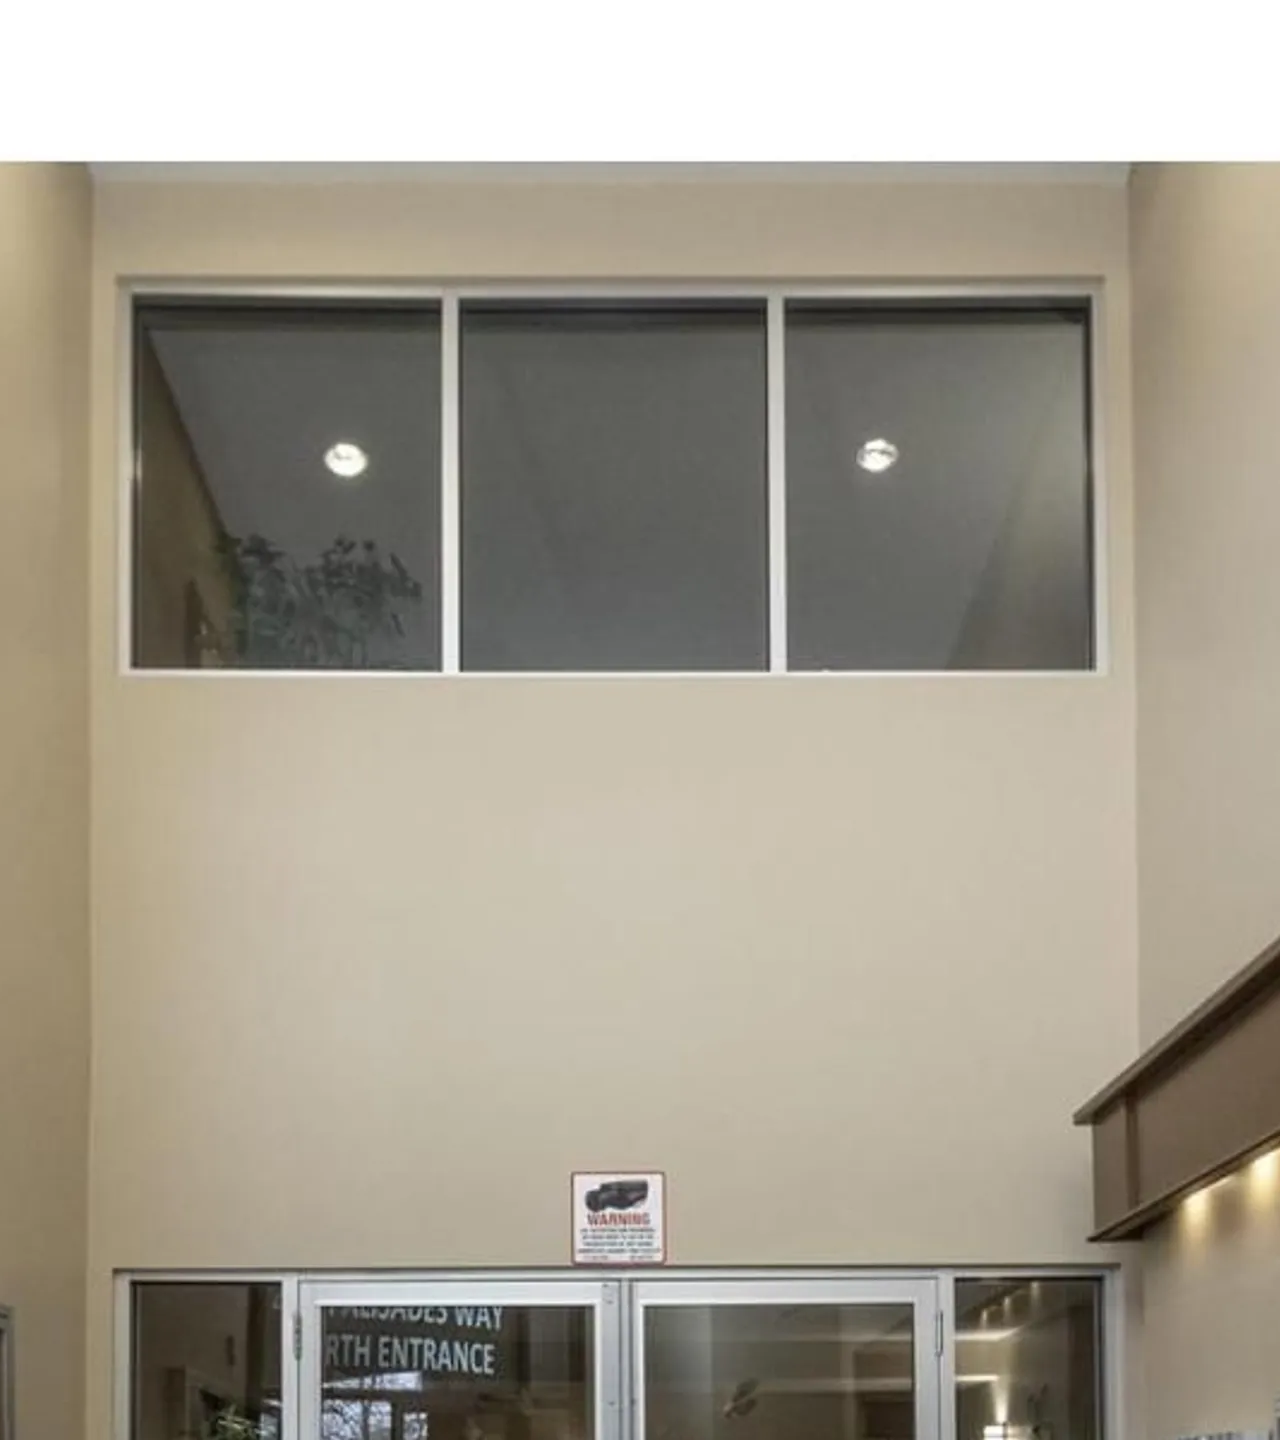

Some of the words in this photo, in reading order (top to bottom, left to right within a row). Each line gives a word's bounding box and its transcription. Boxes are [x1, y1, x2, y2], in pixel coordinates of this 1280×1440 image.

[587, 1212, 651, 1226] WARNING
[455, 1306, 503, 1331] WAY
[378, 1337, 496, 1375] ENTRANCE
